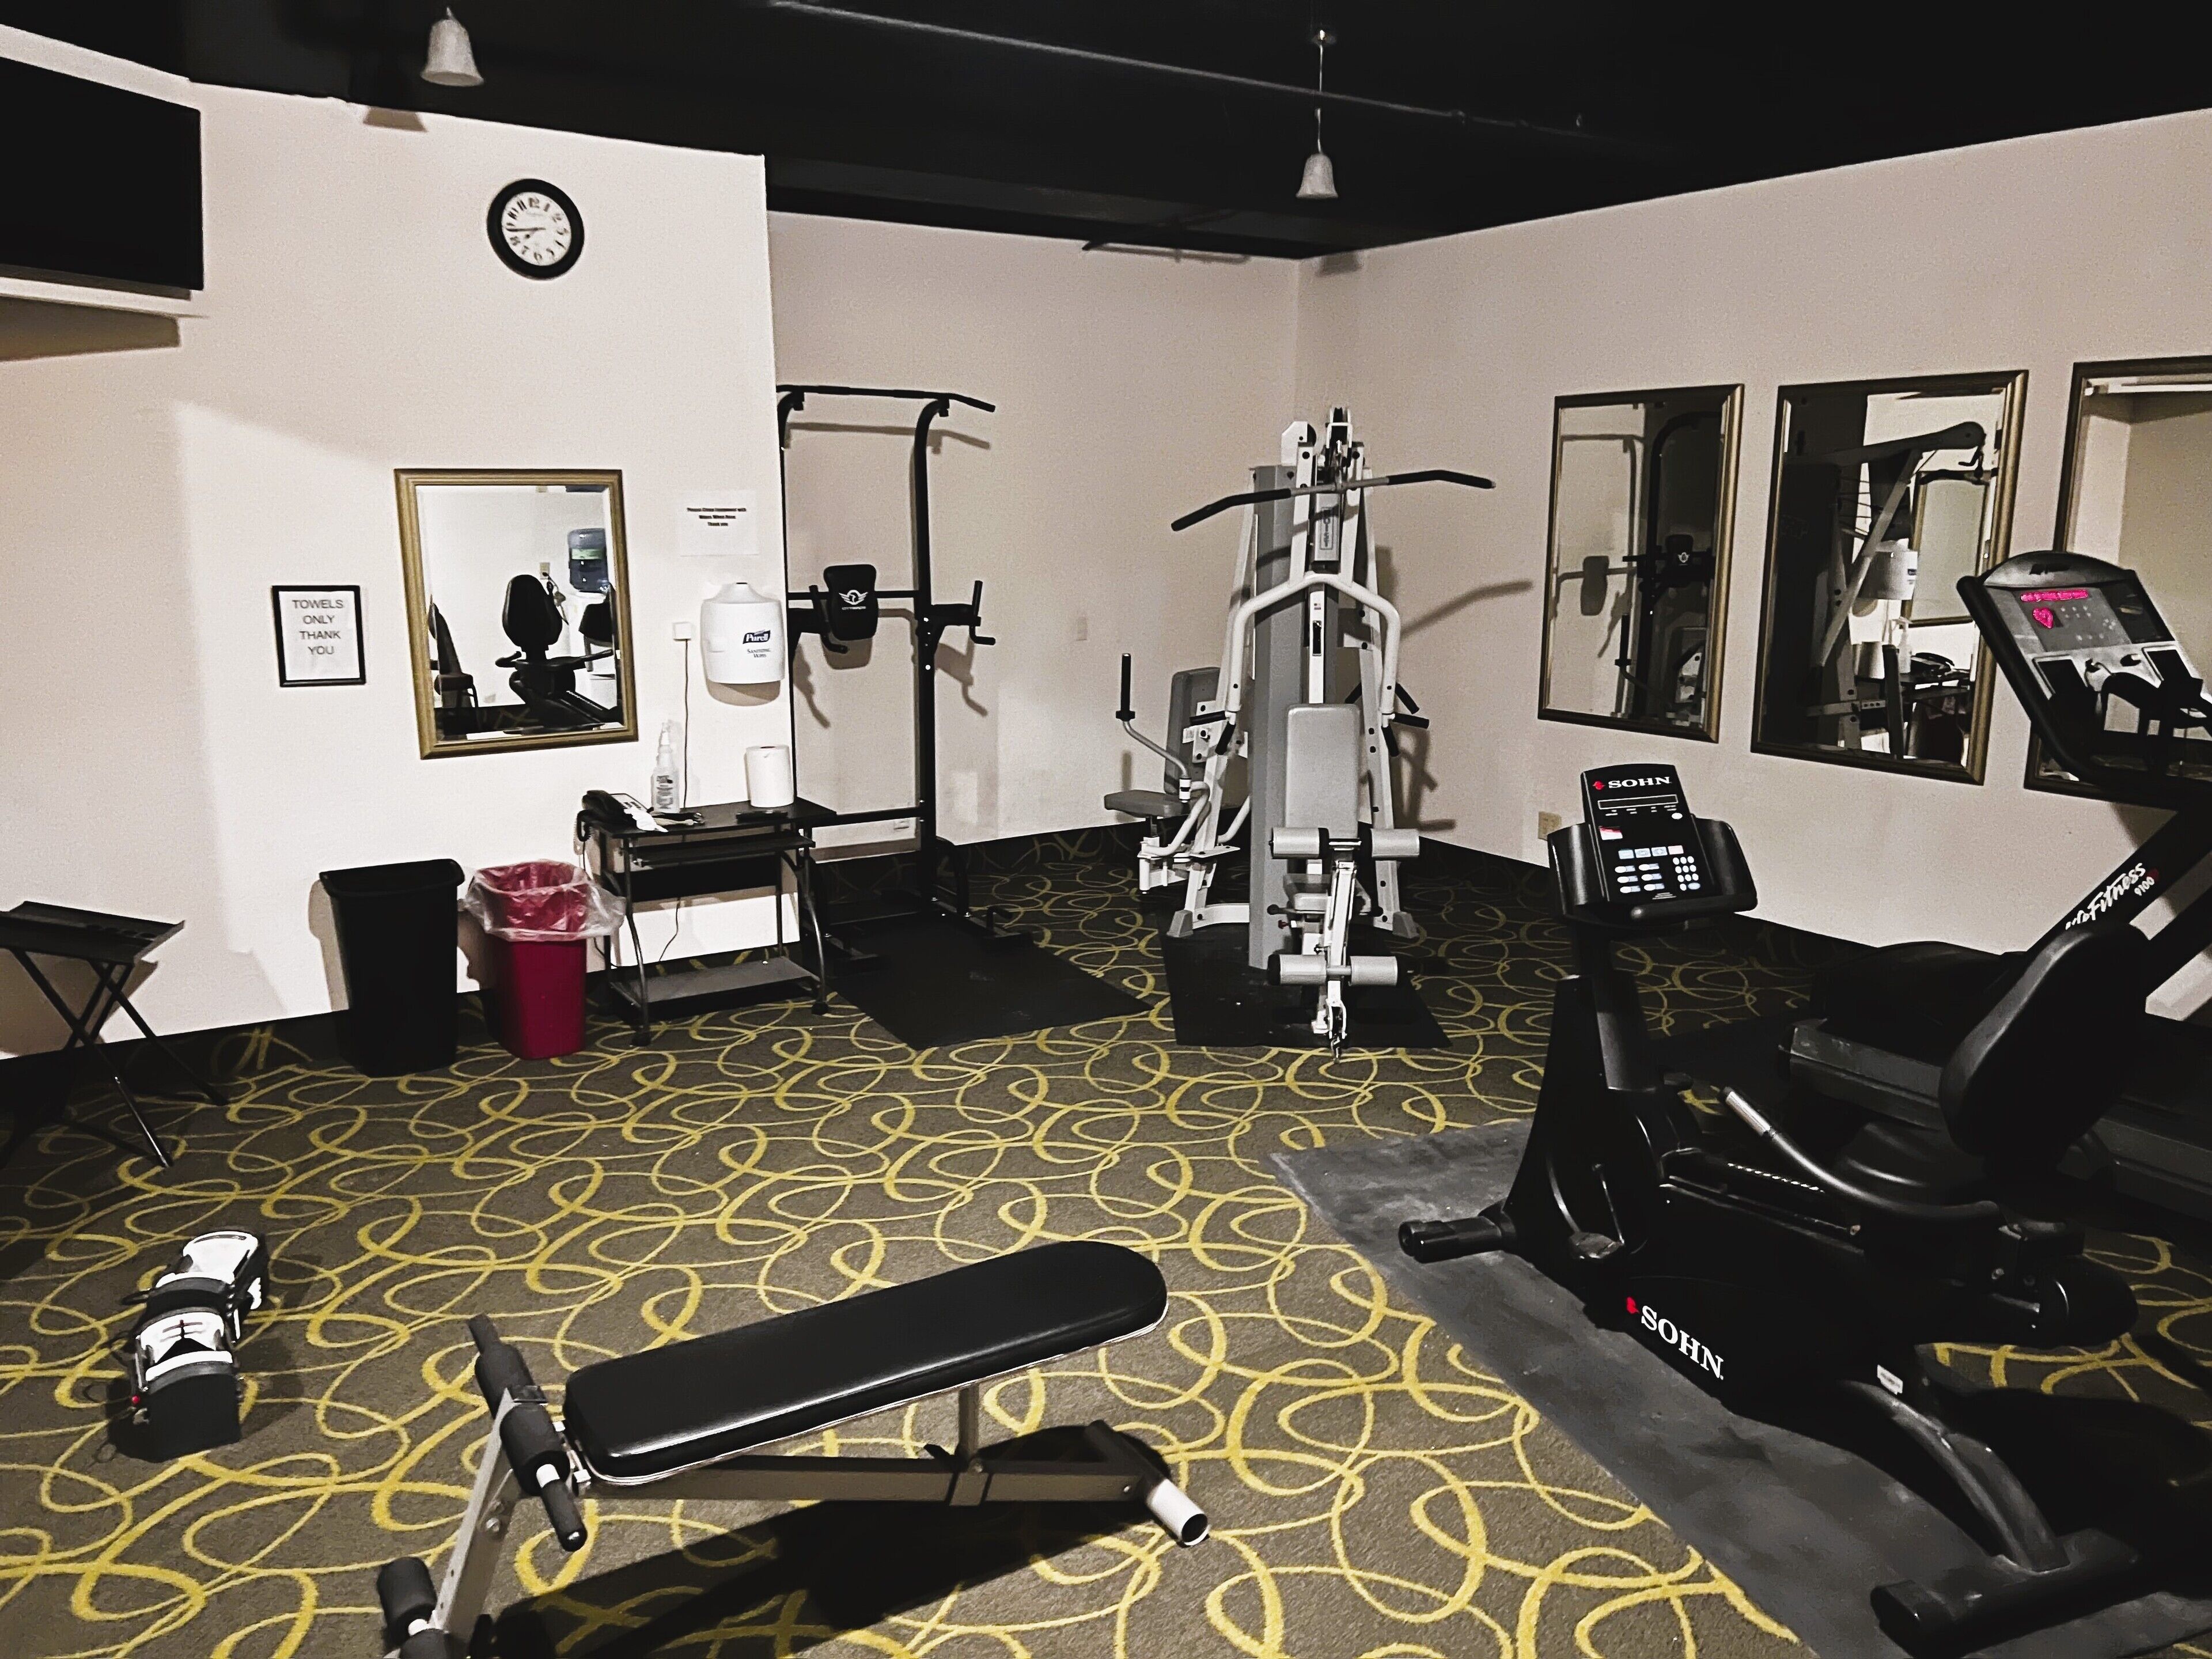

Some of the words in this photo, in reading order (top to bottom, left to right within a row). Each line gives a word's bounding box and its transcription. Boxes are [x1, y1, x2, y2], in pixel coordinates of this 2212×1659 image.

[292, 599, 344, 608] TOWELS
[302, 615, 335, 624] ONLY
[299, 630, 342, 639] THANK
[308, 645, 335, 655] YOU
[1608, 777, 1671, 789] SOHN
[1641, 1305, 1724, 1380] SOHN
